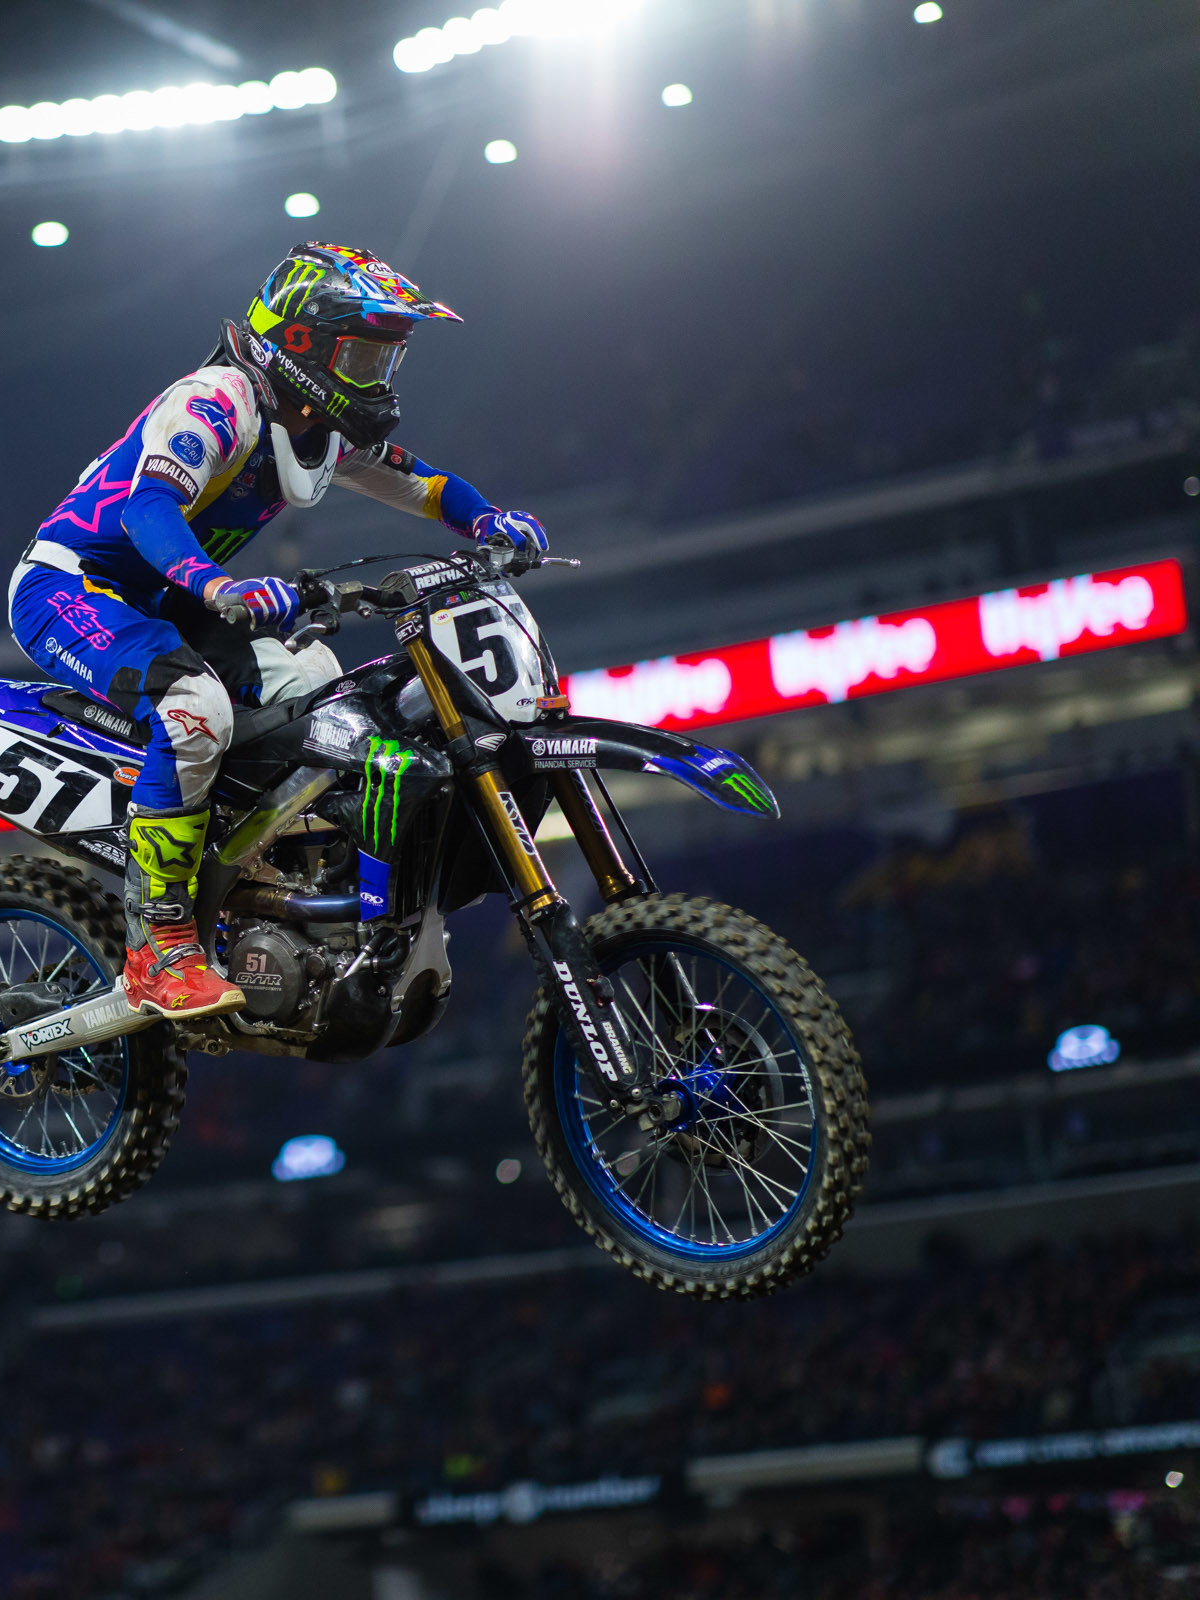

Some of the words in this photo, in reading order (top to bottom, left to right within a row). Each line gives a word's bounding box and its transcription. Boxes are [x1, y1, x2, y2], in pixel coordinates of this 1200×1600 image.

[275, 349, 327, 401] MONSTER
[145, 458, 198, 497] YAMALUBE
[56, 645, 93, 683] YAMAHA
[94, 709, 133, 736] YAMAHA
[309, 719, 352, 750] YAMALUBE
[546, 739, 597, 755] YAMAHA
[534, 761, 567, 769] FINANCIAL
[567, 759, 597, 768] SERVICES
[101, 851, 126, 867] CIRC
[245, 952, 267, 973] 51
[235, 972, 282, 986] GYTR
[82, 999, 135, 1029] YAMALU
[552, 960, 618, 1082] DUNLOP
[20, 1018, 74, 1051] VORTEX
[601, 1021, 634, 1076] BRAKING
